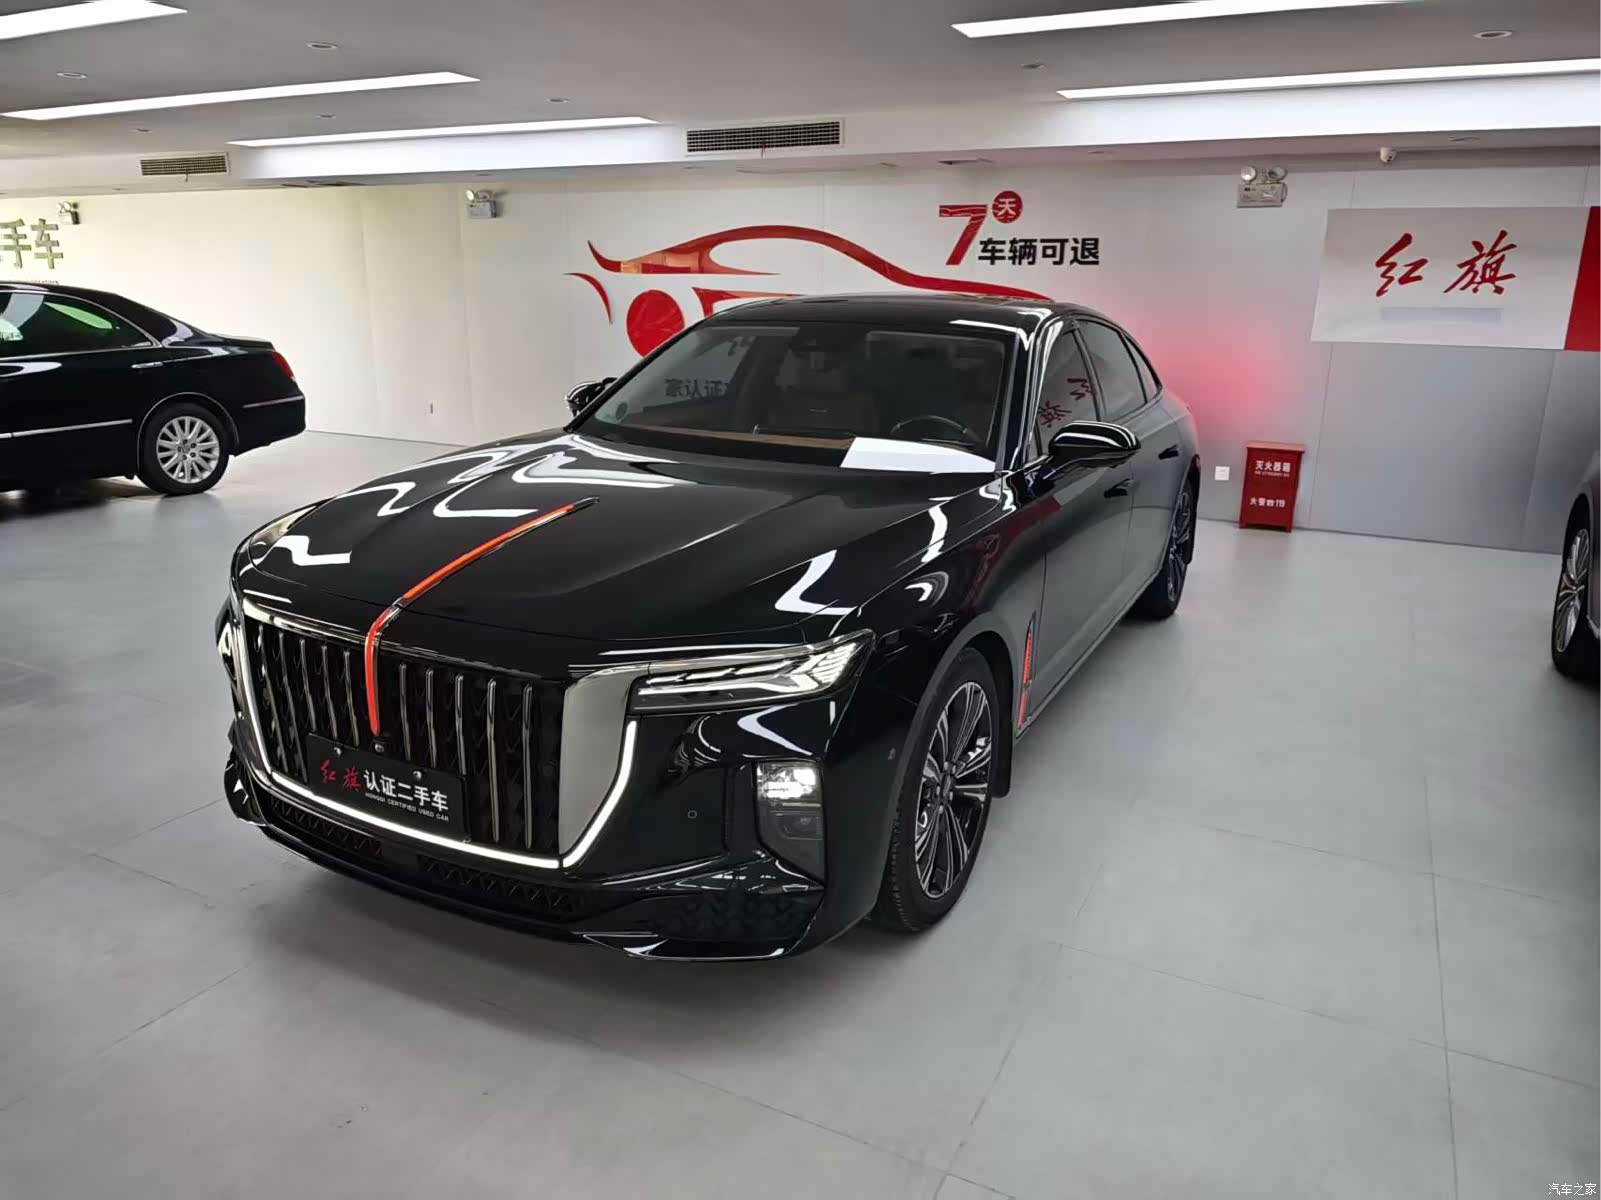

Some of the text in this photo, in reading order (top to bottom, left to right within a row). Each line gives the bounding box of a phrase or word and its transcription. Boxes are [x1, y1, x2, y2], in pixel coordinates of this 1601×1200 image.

[978, 237, 1100, 266] 车辆可退
[1375, 230, 1518, 297] 红旗
[1254, 460, 1291, 474] 灭火器箱
[363, 770, 448, 811] 认证二手车
[388, 799, 417, 812] CERTIFIED
[418, 808, 434, 818] USED
[436, 814, 449, 822] CAR
